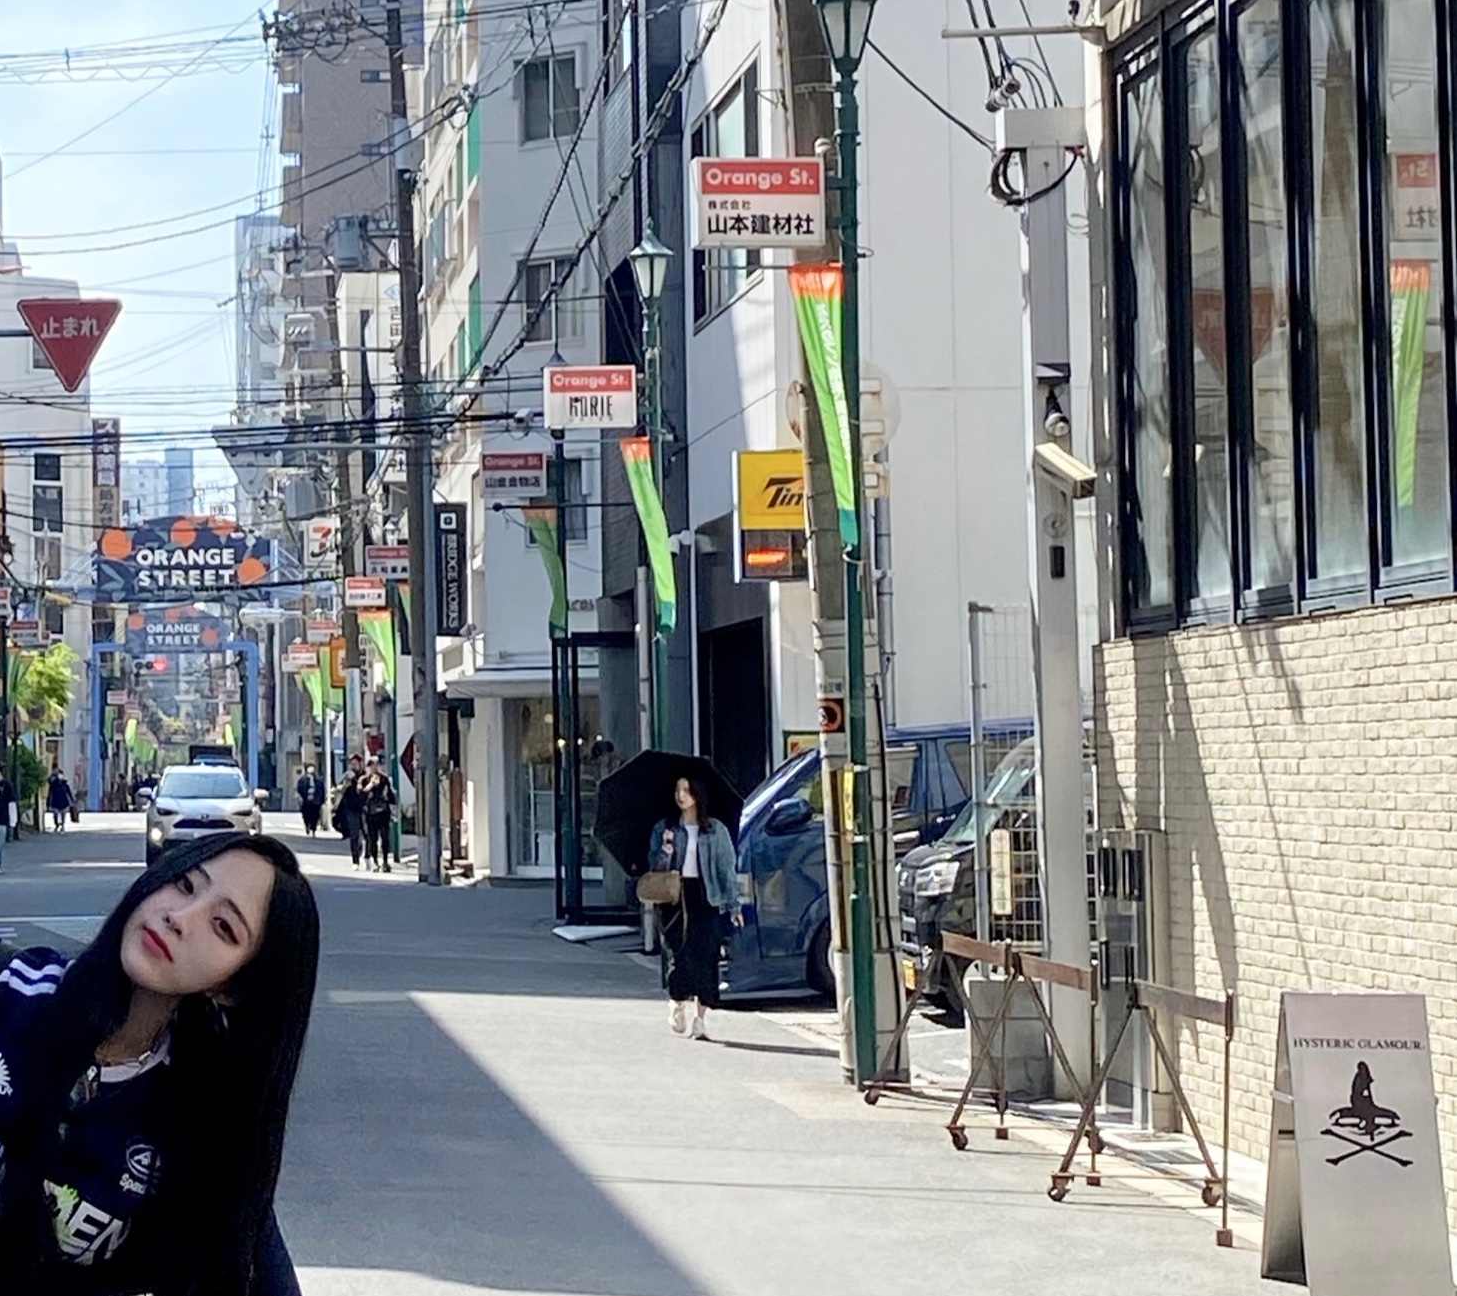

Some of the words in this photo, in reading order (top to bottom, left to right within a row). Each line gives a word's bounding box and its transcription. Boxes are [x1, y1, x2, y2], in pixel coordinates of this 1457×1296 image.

[706, 168, 783, 190] Orange
[789, 167, 815, 186] St.
[708, 199, 751, 211] 株式会社
[707, 213, 815, 235] 山本建材社
[40, 316, 100, 338] 止まれ
[552, 373, 607, 389] Orange
[610, 372, 629, 386] St.
[135, 548, 236, 566] ORANGE
[138, 569, 236, 587] STREET
[146, 623, 201, 634] ORANGE
[146, 635, 201, 646] STREET
[1293, 1038, 1355, 1049] HYSTERIC
